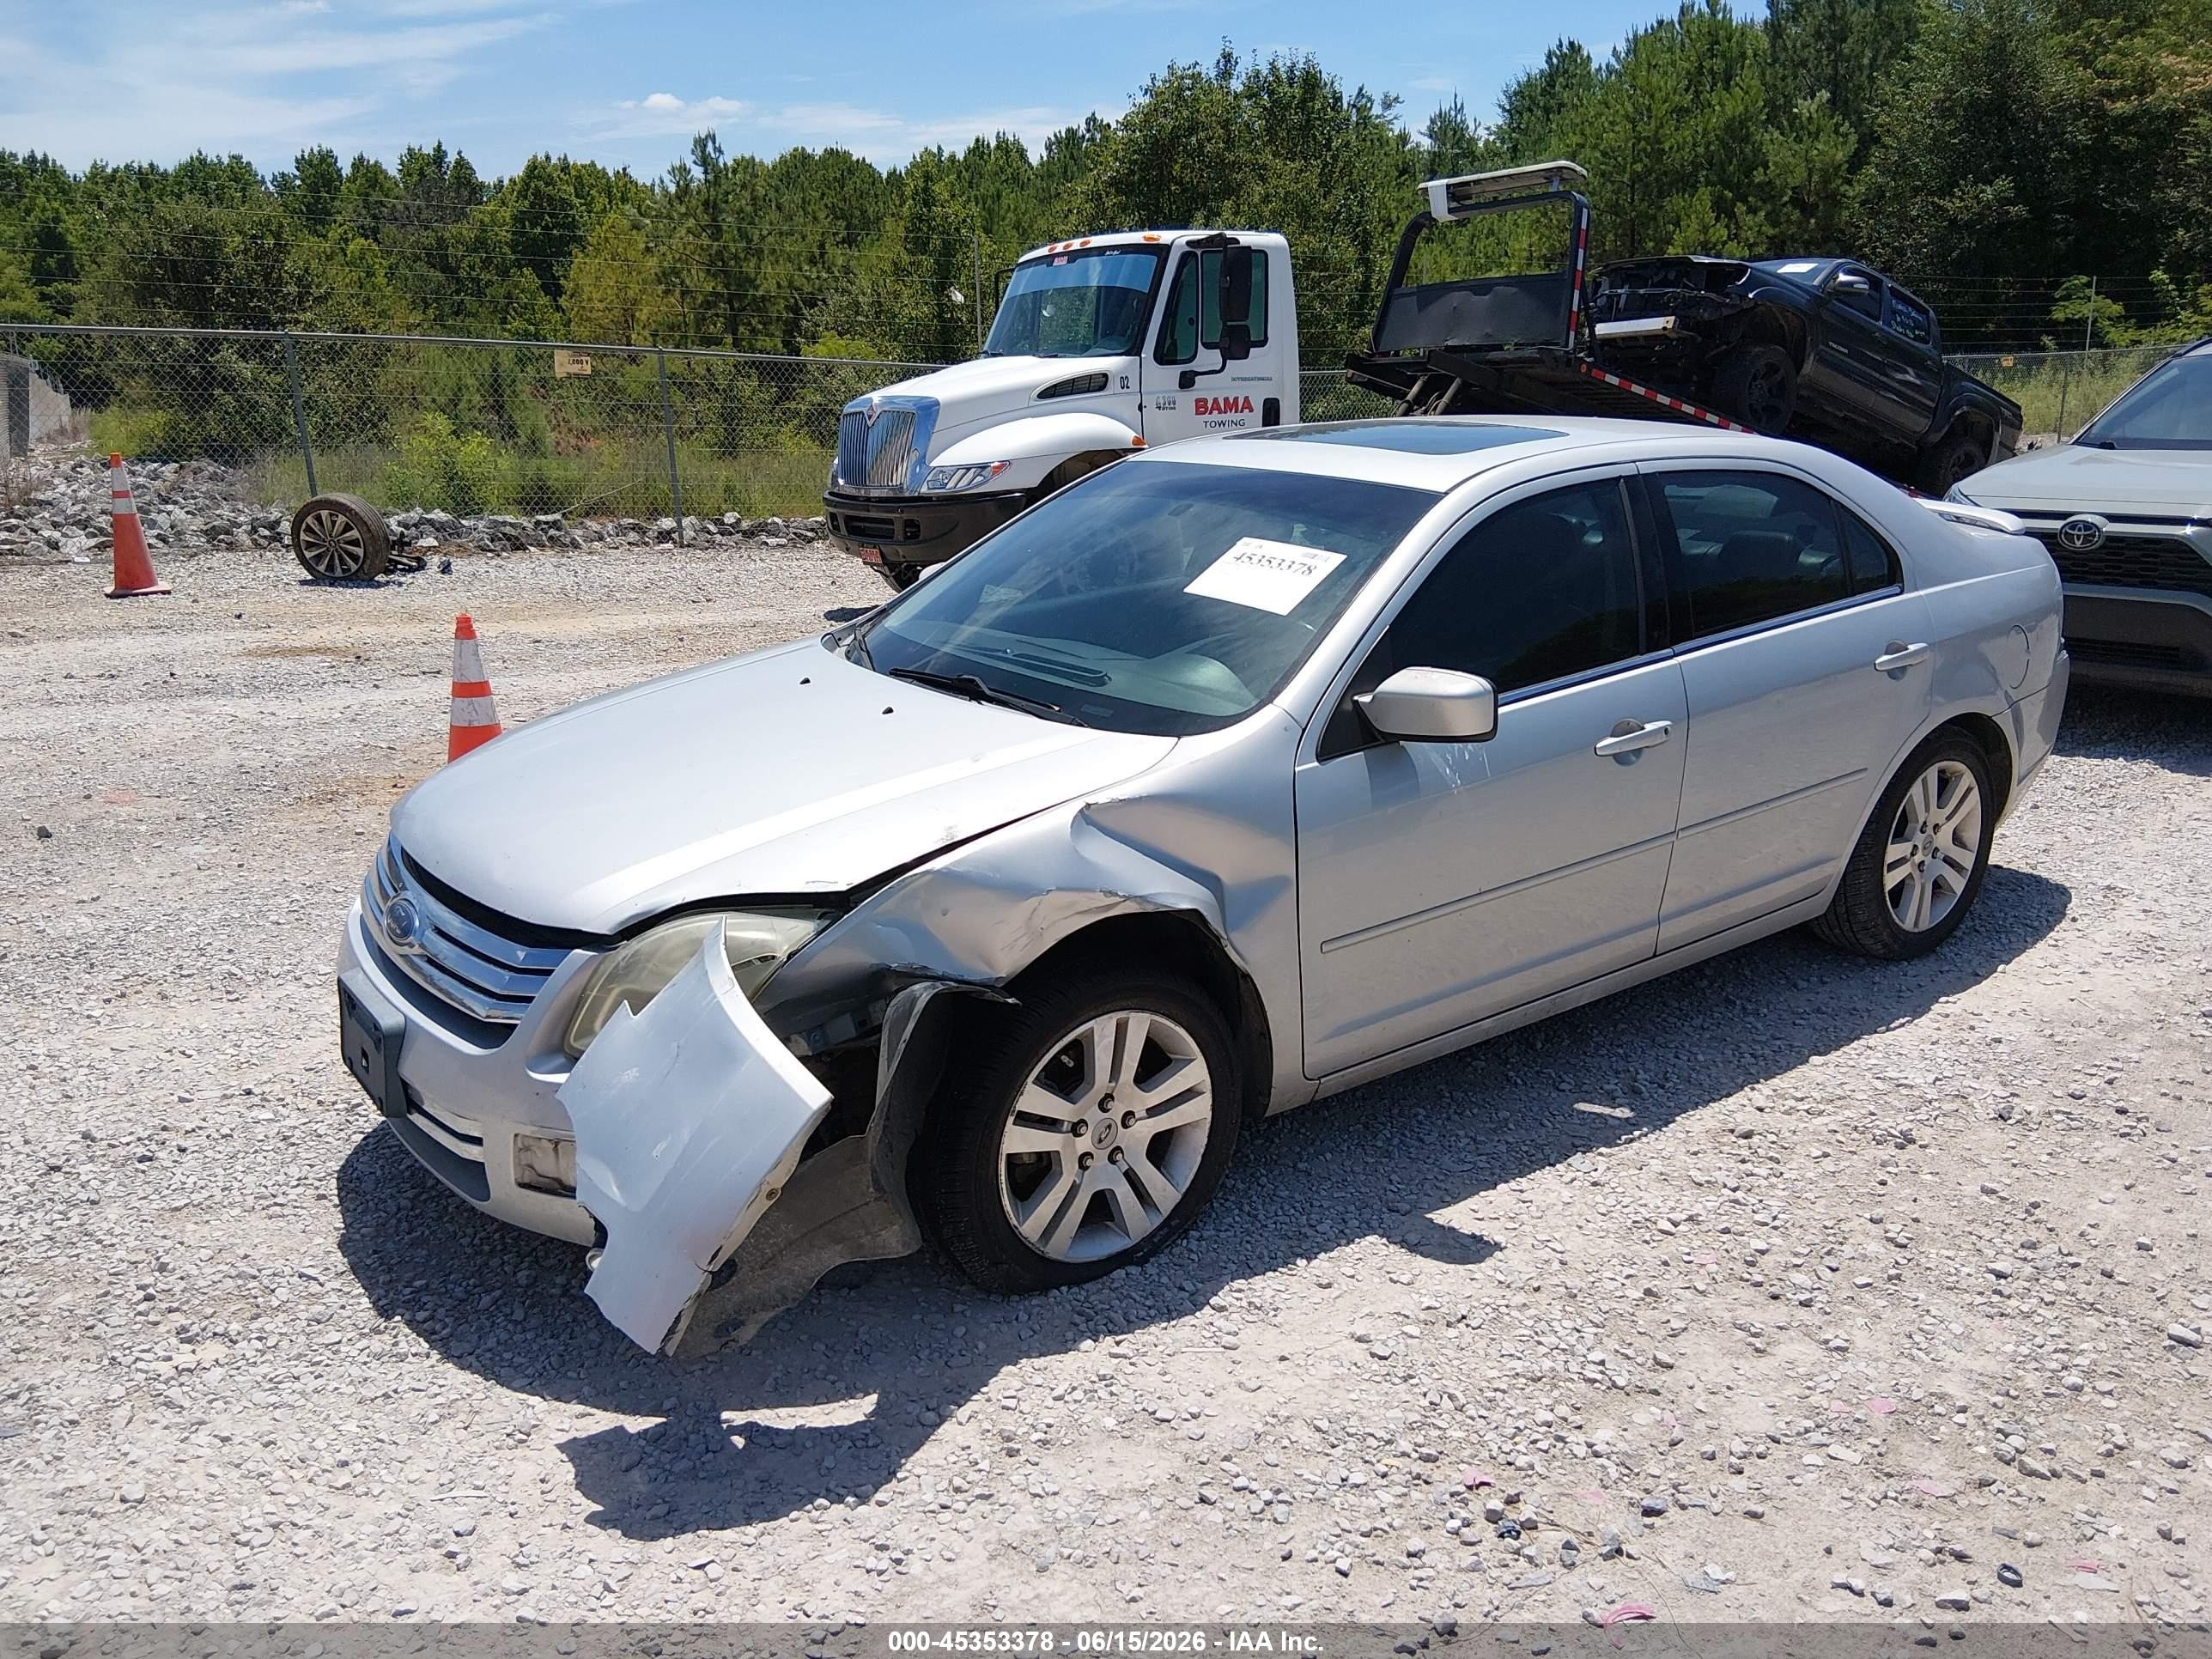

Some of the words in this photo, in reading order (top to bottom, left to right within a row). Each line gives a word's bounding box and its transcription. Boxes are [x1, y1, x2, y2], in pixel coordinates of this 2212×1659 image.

[1120, 375, 1130, 390] 02
[1194, 396, 1254, 416] BAMA
[1203, 418, 1246, 428] TOWING
[1233, 551, 1317, 576] 45353378
